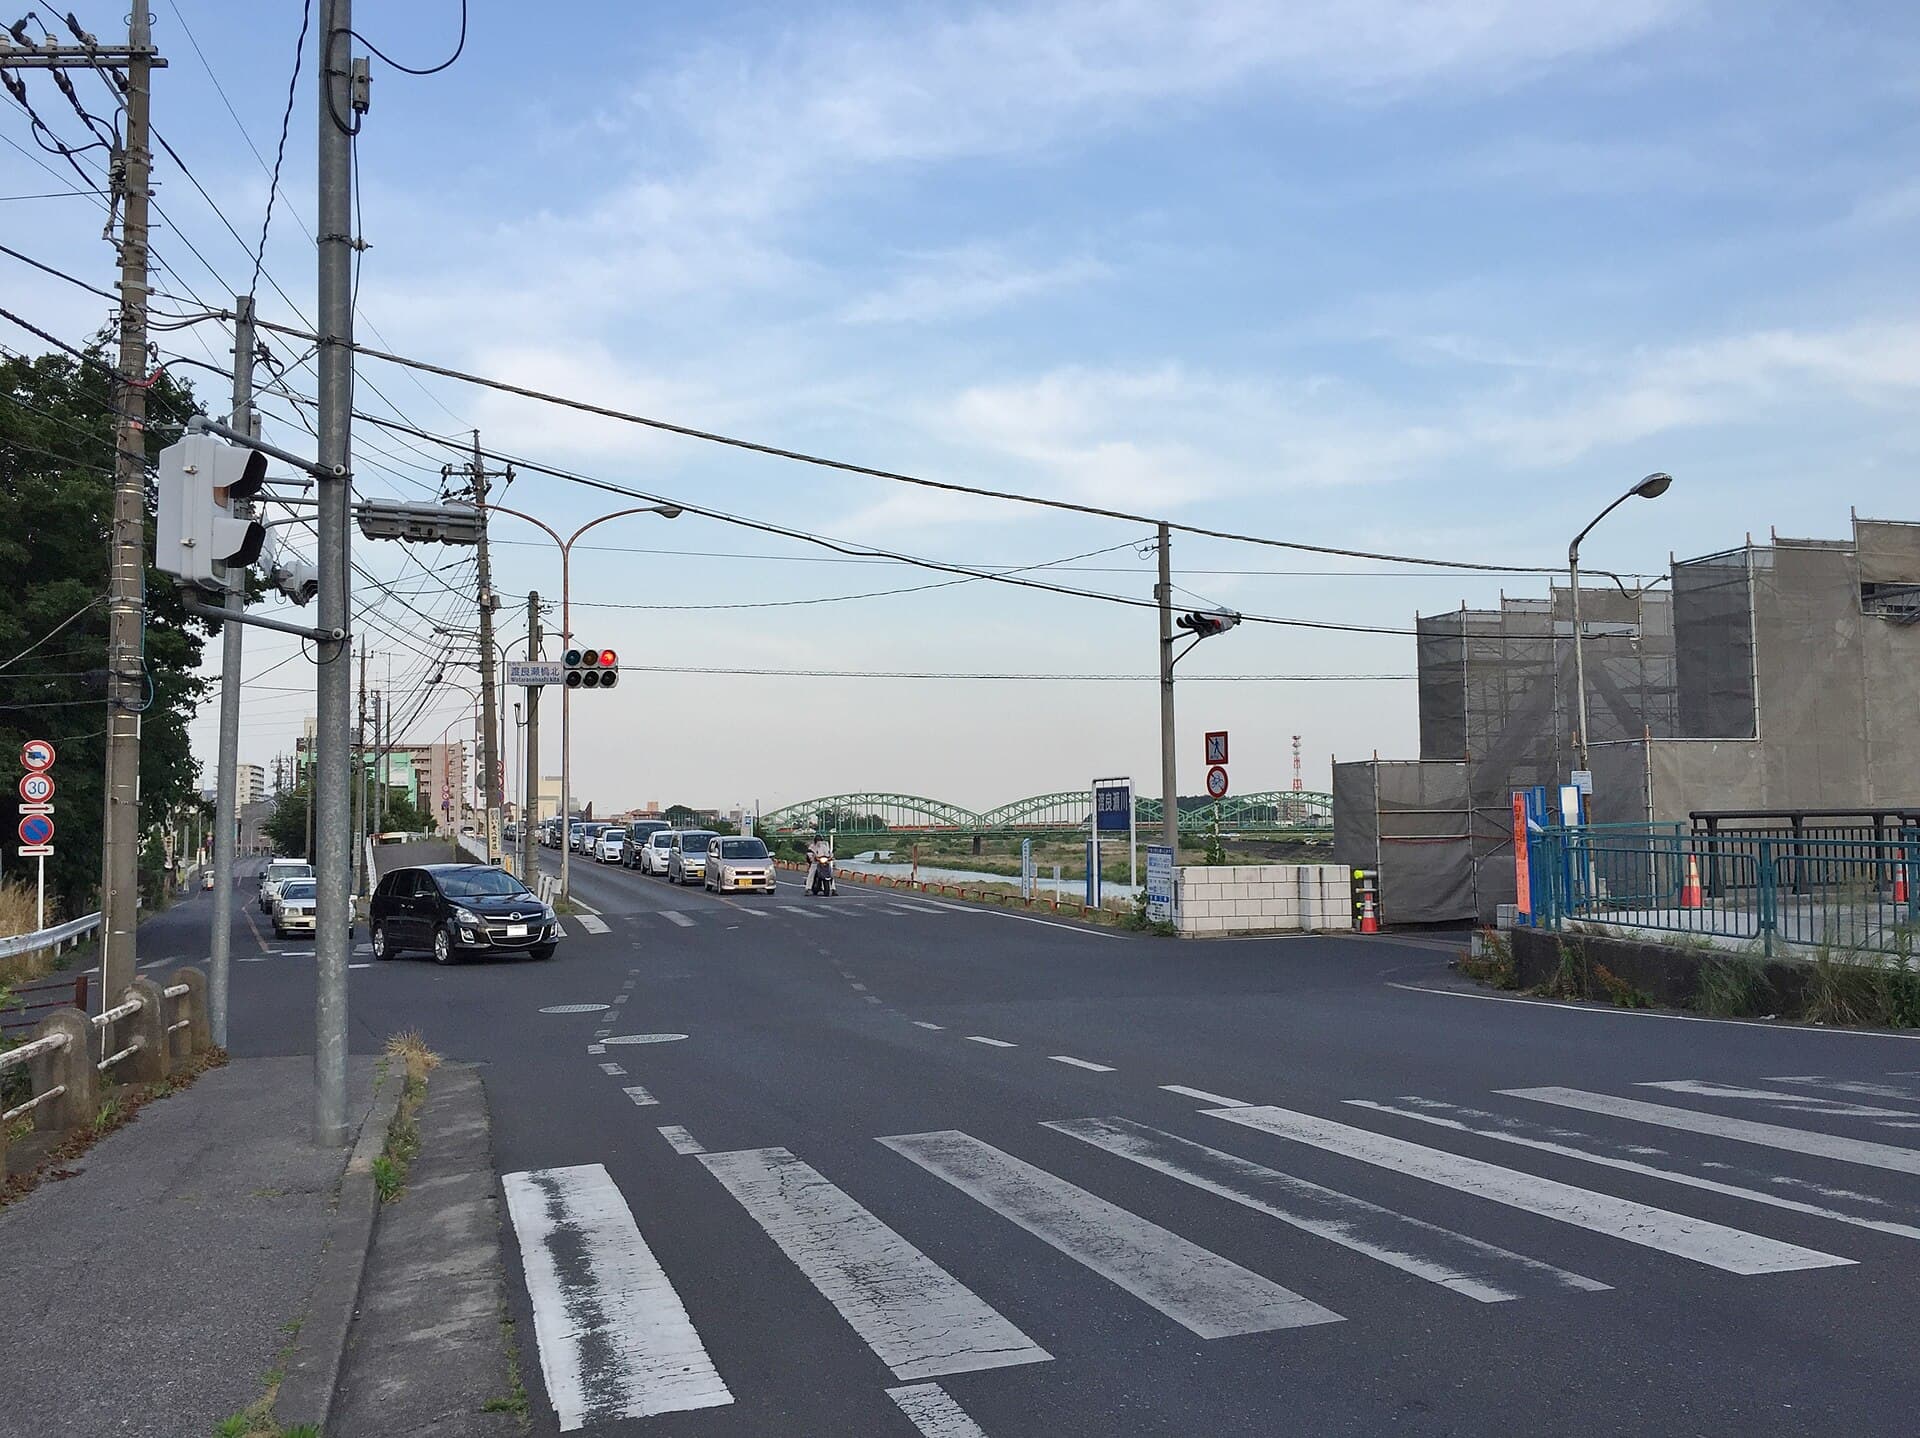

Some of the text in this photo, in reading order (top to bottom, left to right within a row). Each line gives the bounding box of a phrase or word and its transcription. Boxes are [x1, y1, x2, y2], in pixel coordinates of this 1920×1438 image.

[28, 781, 47, 795] 30
[1098, 791, 1128, 812] 渡良瀬川
